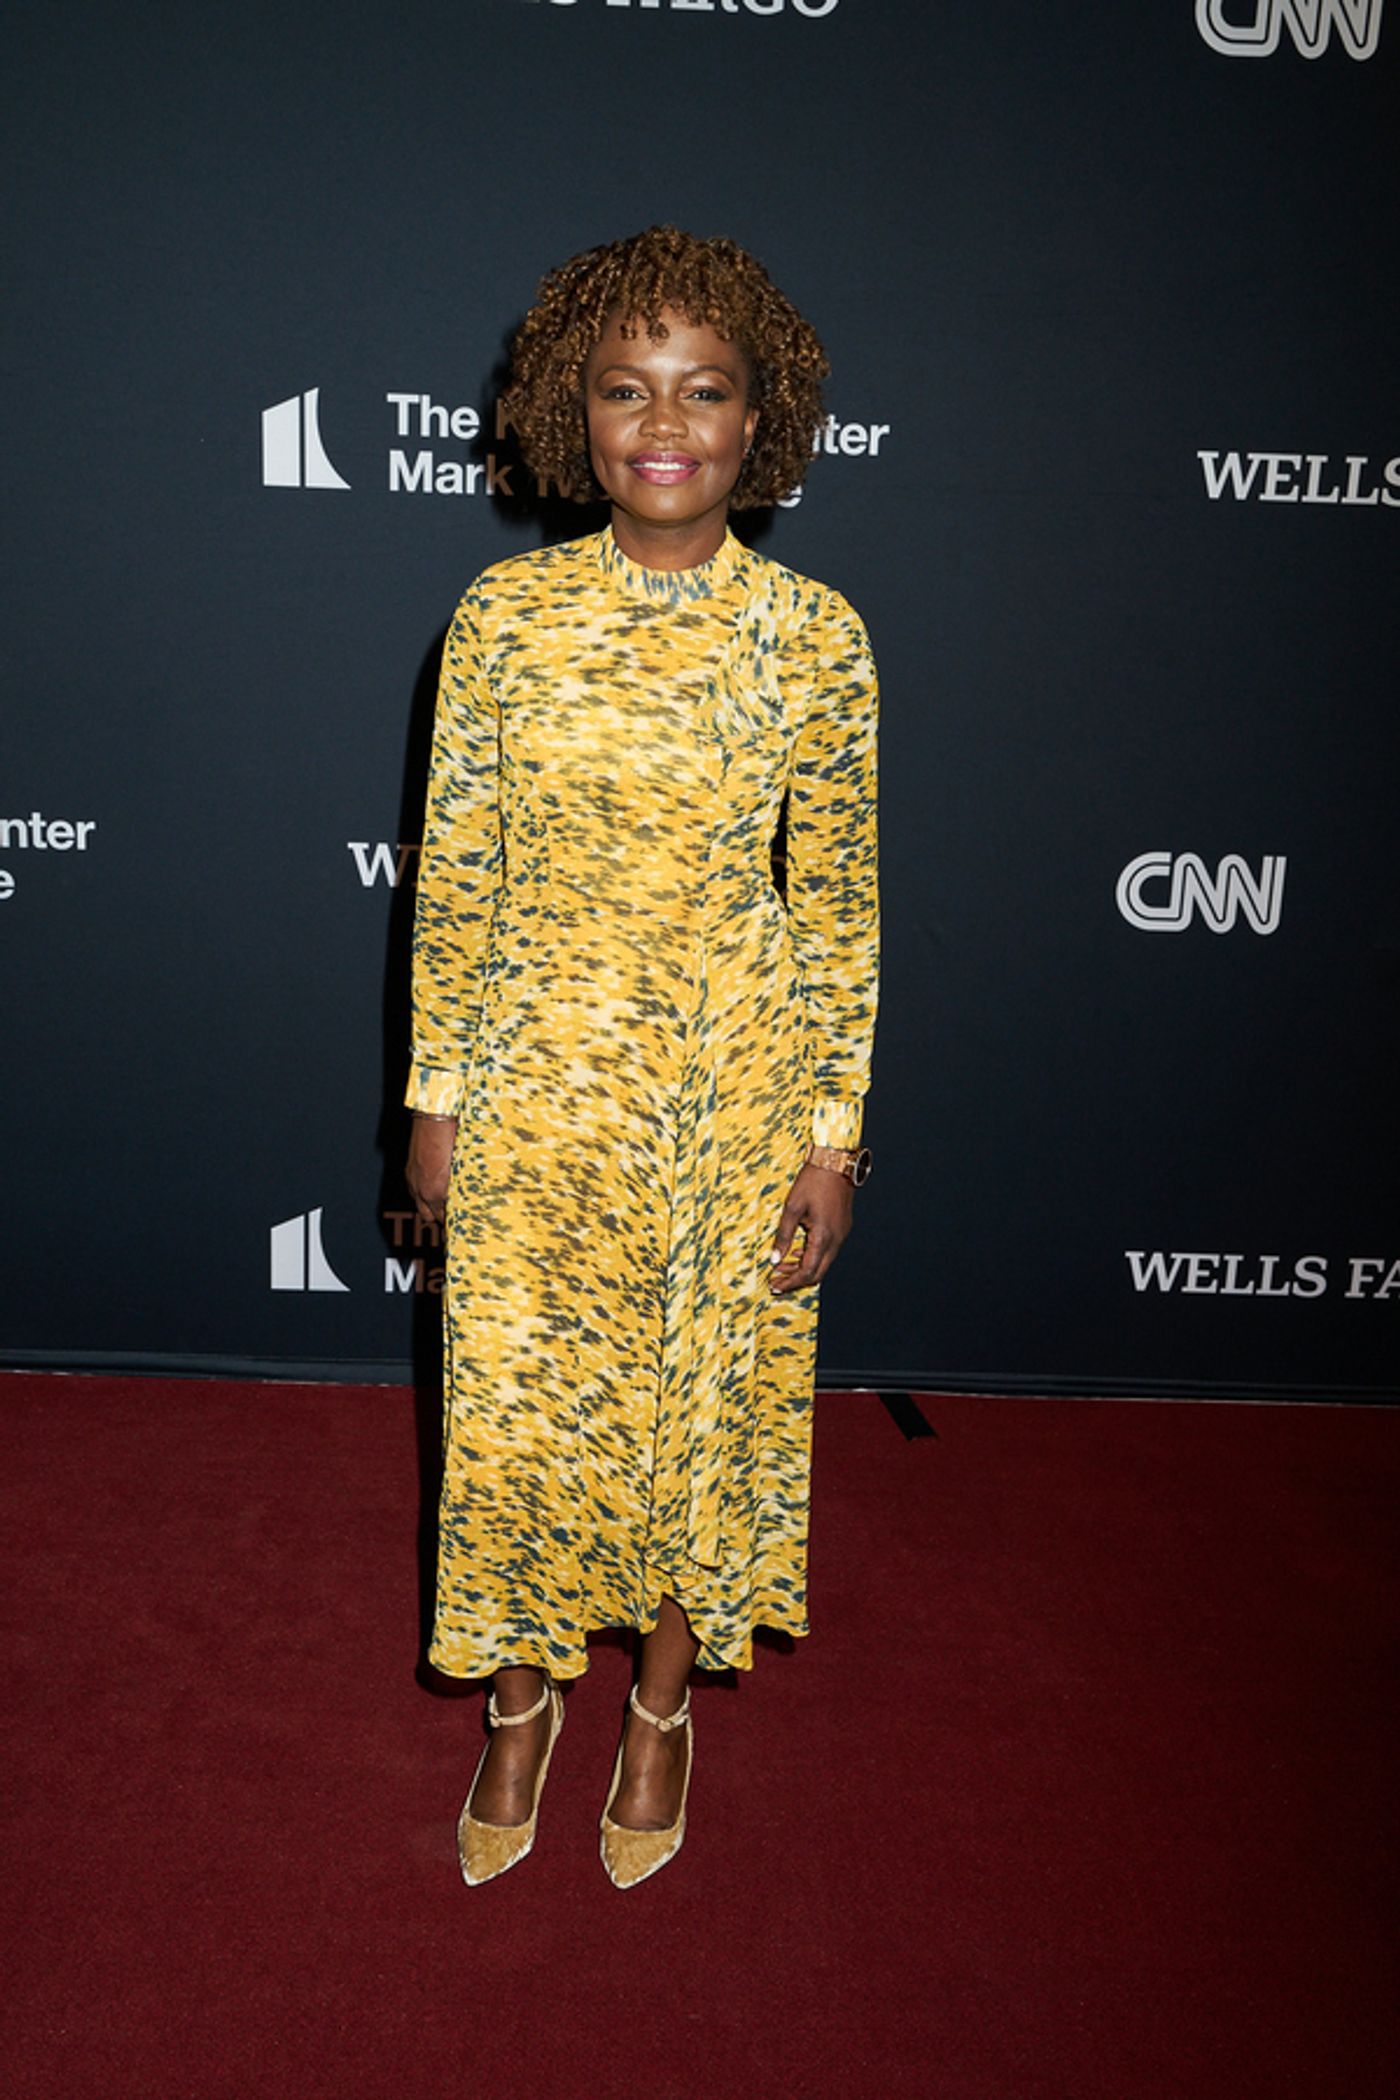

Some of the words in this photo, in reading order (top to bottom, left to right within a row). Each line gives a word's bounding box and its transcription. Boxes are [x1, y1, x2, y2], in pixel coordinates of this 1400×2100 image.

[1194, 0, 1385, 61] CNN
[387, 393, 480, 440] The
[389, 449, 514, 496] Mark
[1115, 851, 1287, 935] CNN
[1125, 1251, 1328, 1299] WELLS
